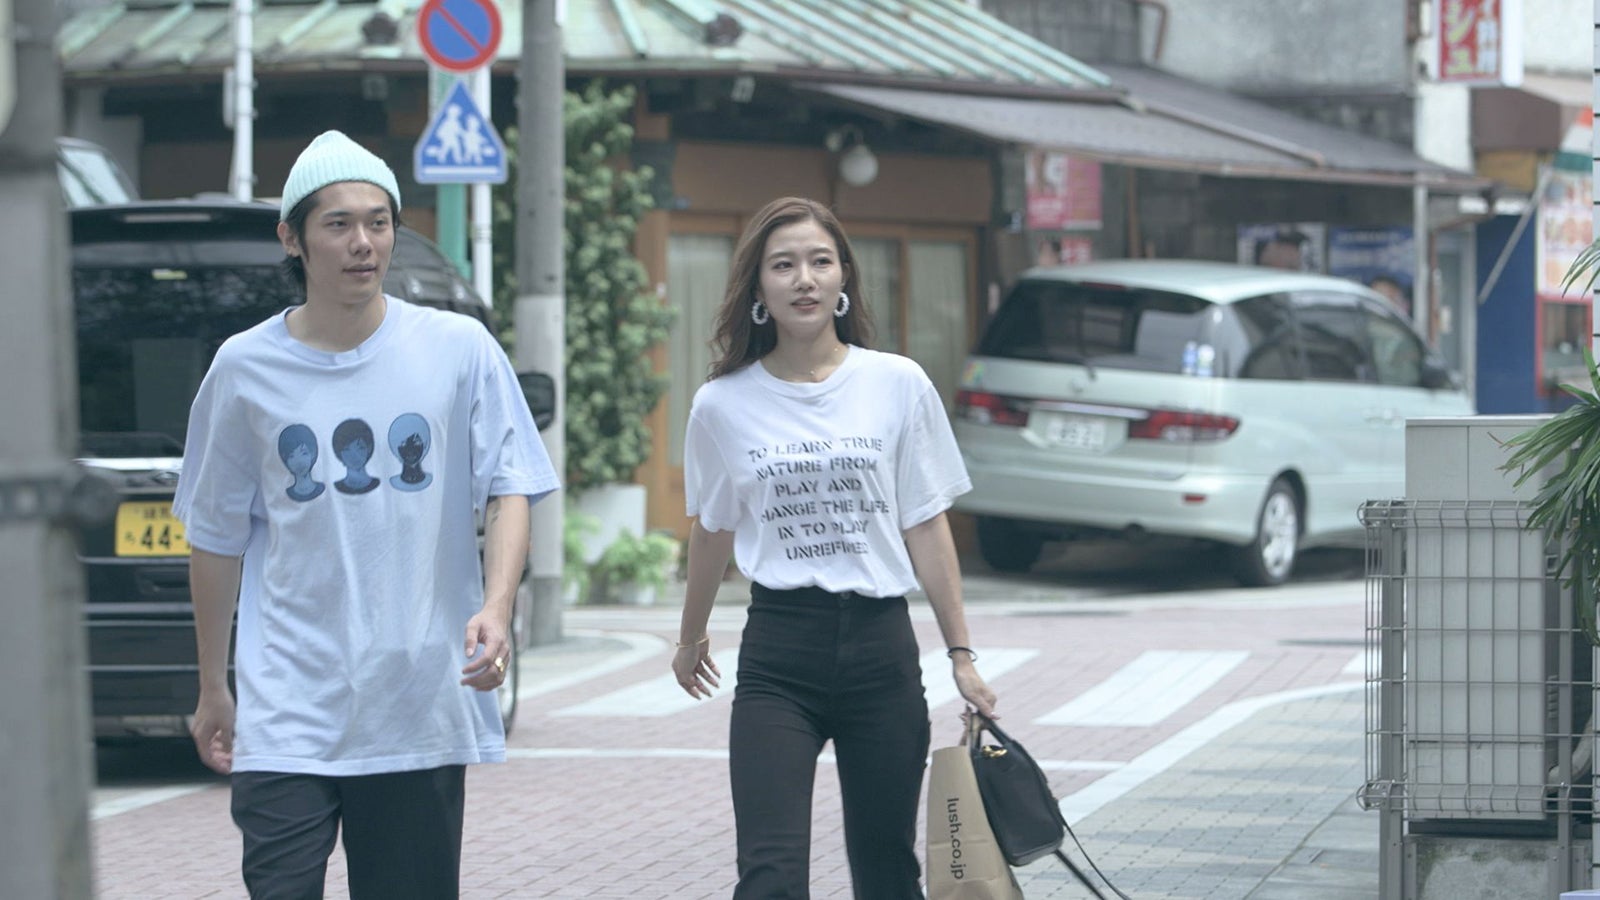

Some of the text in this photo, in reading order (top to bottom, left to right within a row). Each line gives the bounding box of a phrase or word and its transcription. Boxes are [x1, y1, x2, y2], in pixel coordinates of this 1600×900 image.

[748, 436, 883, 463] TO LEARN TRUE
[756, 456, 878, 481] NATURE FROM
[774, 477, 862, 498] PLAY AND
[760, 499, 890, 524] HANGE THE LIFE
[777, 520, 870, 540] IN TO PLAY
[946, 797, 967, 880] lush.co.jp
